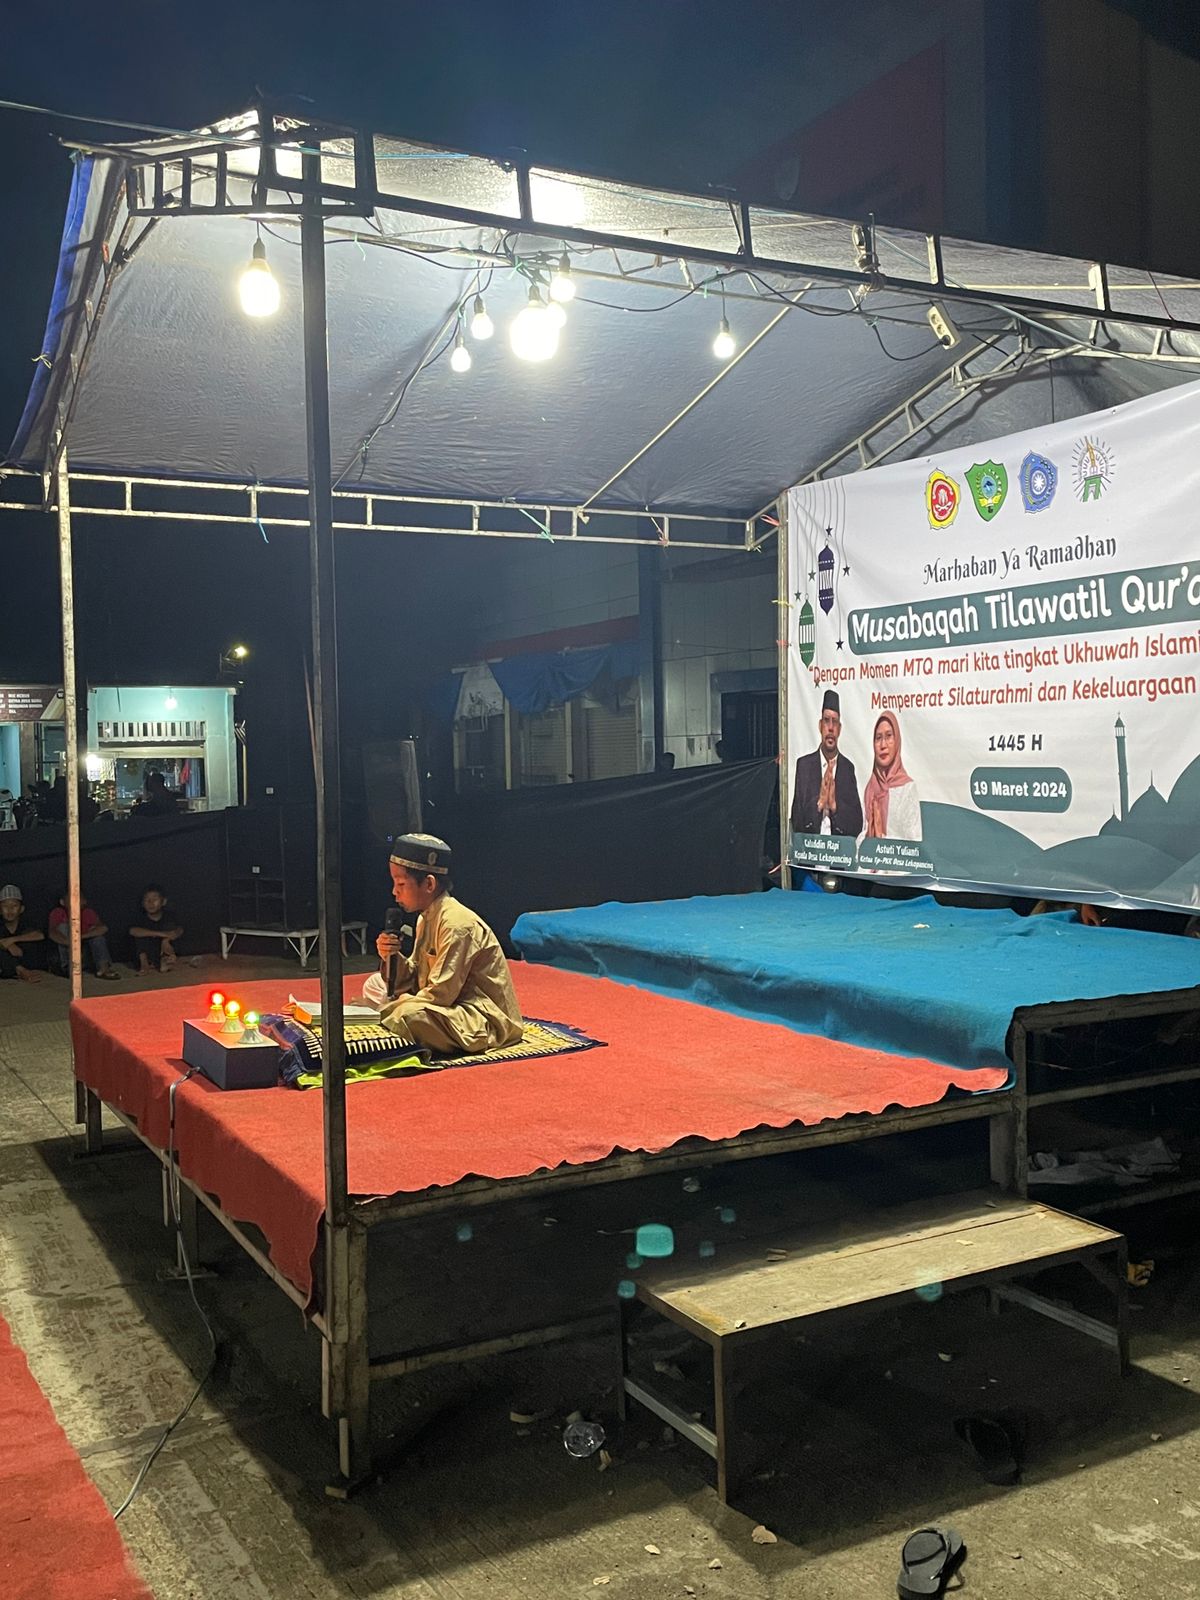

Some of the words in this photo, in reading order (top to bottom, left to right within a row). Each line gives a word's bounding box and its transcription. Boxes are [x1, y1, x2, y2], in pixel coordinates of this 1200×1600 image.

[923, 555, 997, 585] Marhaban
[1000, 548, 1020, 579] Ya
[1025, 535, 1116, 571] Ramadhan
[852, 598, 979, 644] Musabaqah
[984, 578, 1112, 629] Tilawatil
[860, 662, 898, 679] Momen
[903, 657, 933, 677] MTQ
[938, 654, 969, 674] mari
[974, 651, 1000, 671] kita
[1004, 646, 1059, 672] tingkat
[1064, 636, 1139, 664] Ukhuwah
[871, 689, 943, 713] Mempererat
[948, 683, 1032, 706] Silaturahmi
[1038, 681, 1066, 702] dan
[1073, 675, 1196, 702] Kekeluargaan
[988, 734, 1025, 751] 1445
[1031, 734, 1043, 751] H
[973, 781, 988, 796] 19
[991, 781, 1029, 797] Maret
[1032, 781, 1067, 798] 2024
[875, 844, 895, 855] Astuti
